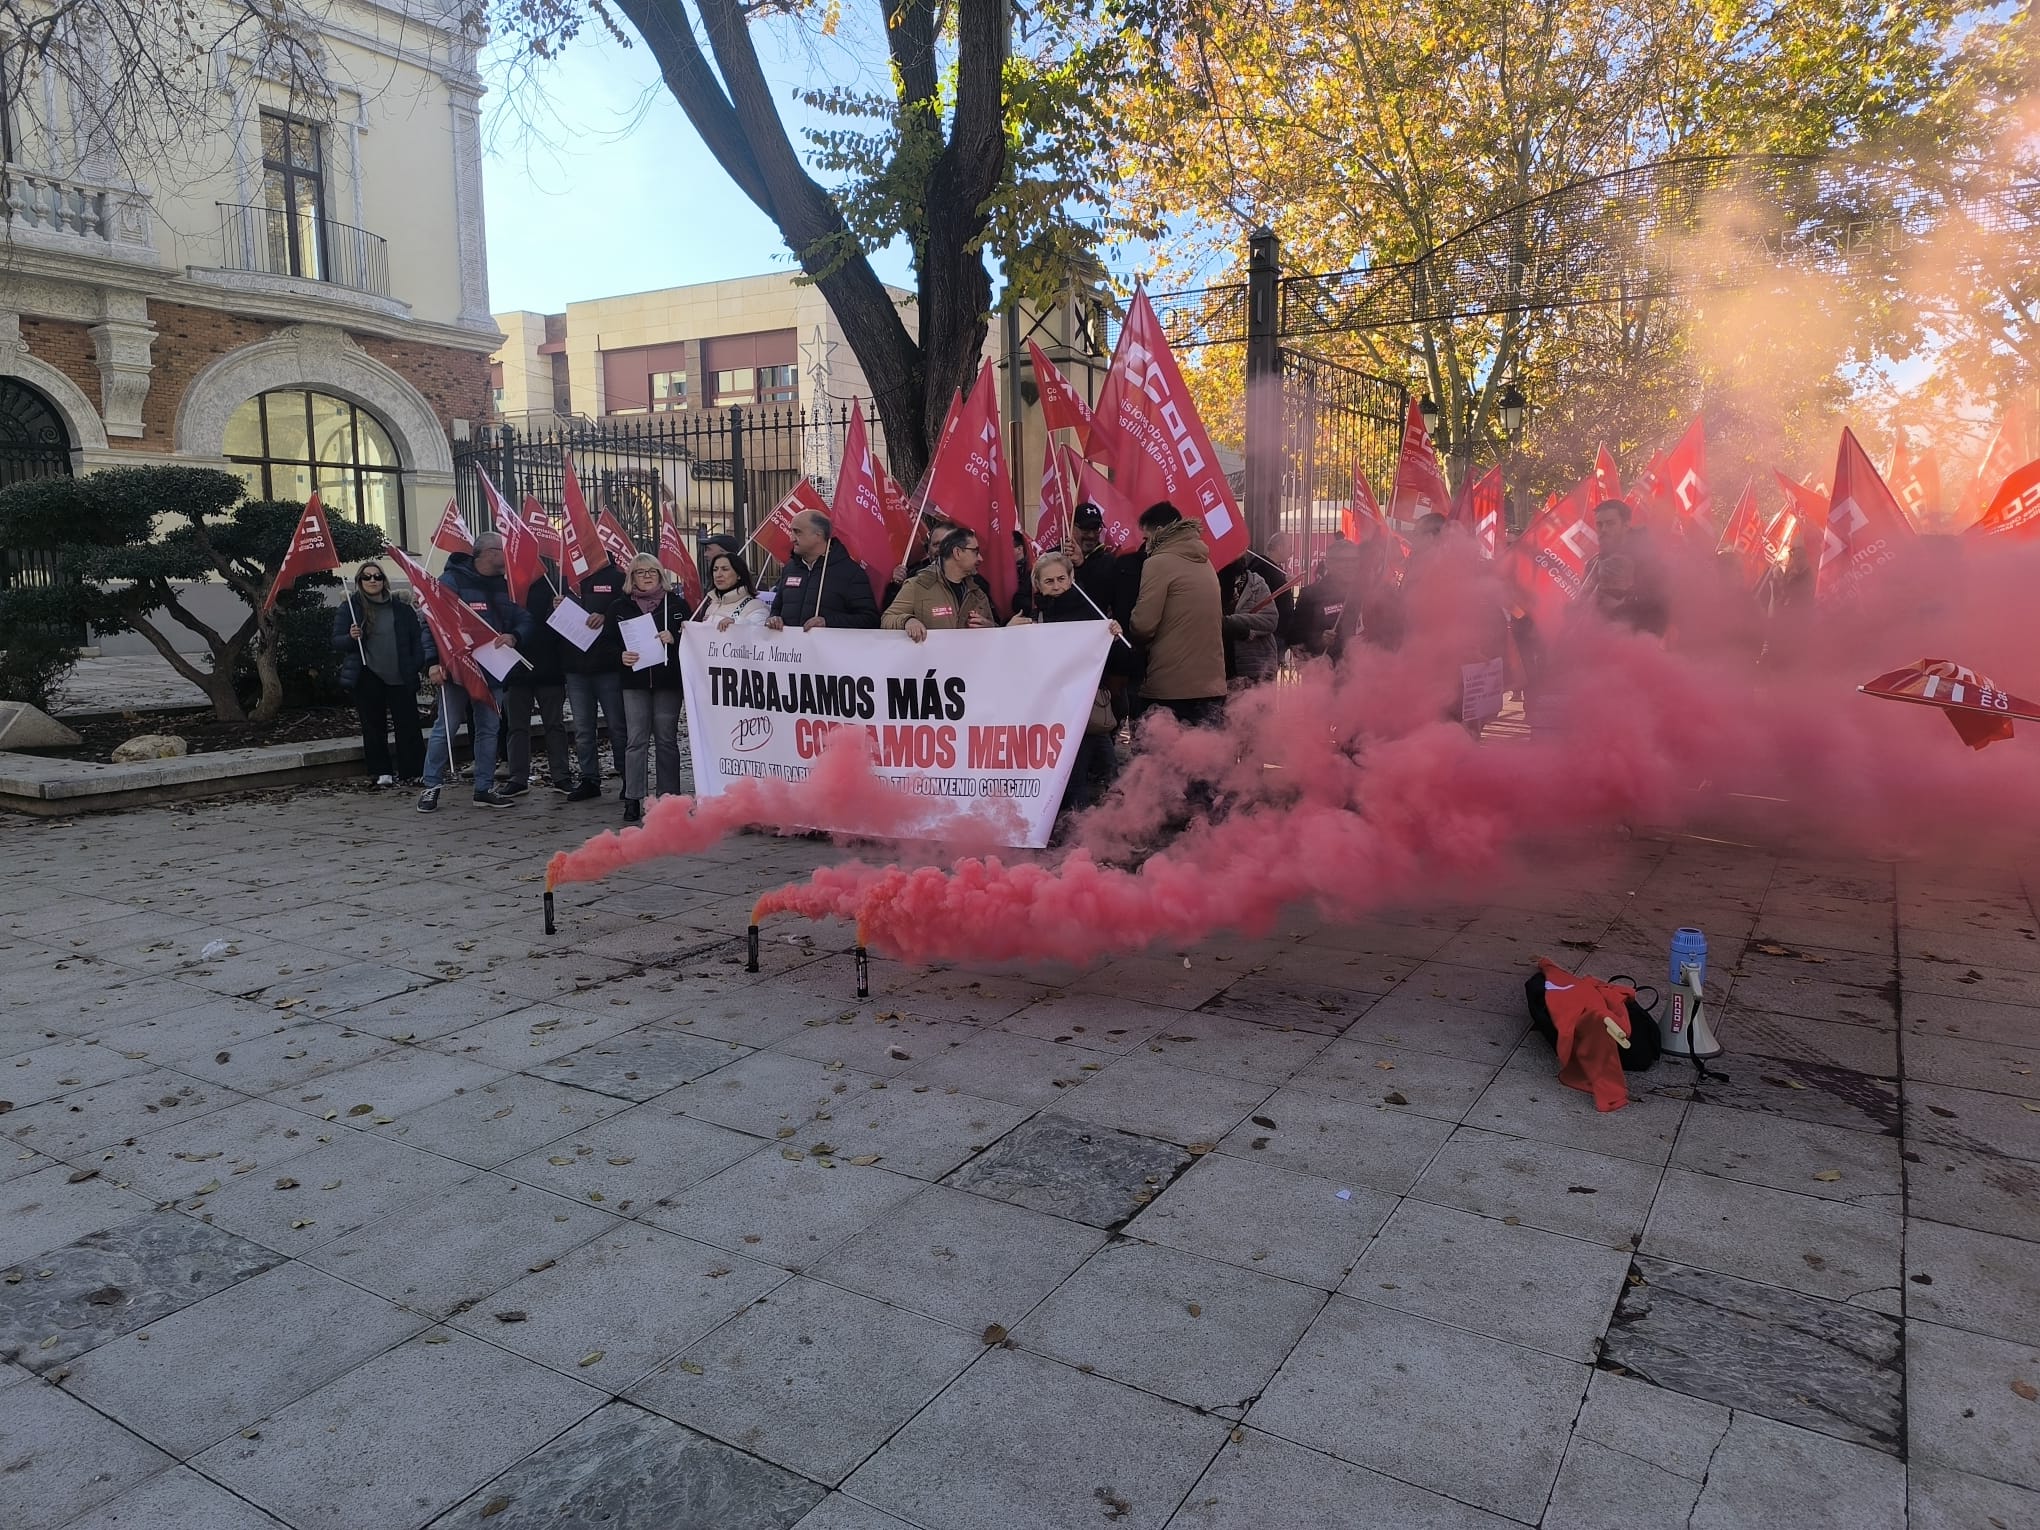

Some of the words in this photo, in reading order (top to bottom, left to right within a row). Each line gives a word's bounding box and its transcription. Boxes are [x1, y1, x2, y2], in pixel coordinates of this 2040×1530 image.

[1124, 341, 1206, 479] CCOO
[965, 462, 979, 475] de
[855, 495, 869, 509] de
[1535, 554, 1549, 568] de
[708, 641, 718, 657] En
[768, 645, 802, 663] Mancha
[708, 666, 875, 720] TRABAJAMOS
[886, 668, 966, 720] MÁS
[739, 714, 771, 746] pero
[795, 718, 957, 769] COAMOS
[966, 723, 1066, 770] MENOS
[719, 757, 766, 779] ORGANIZA
[912, 777, 976, 797] CONVENIO
[979, 778, 1041, 798] COLECTIVO
